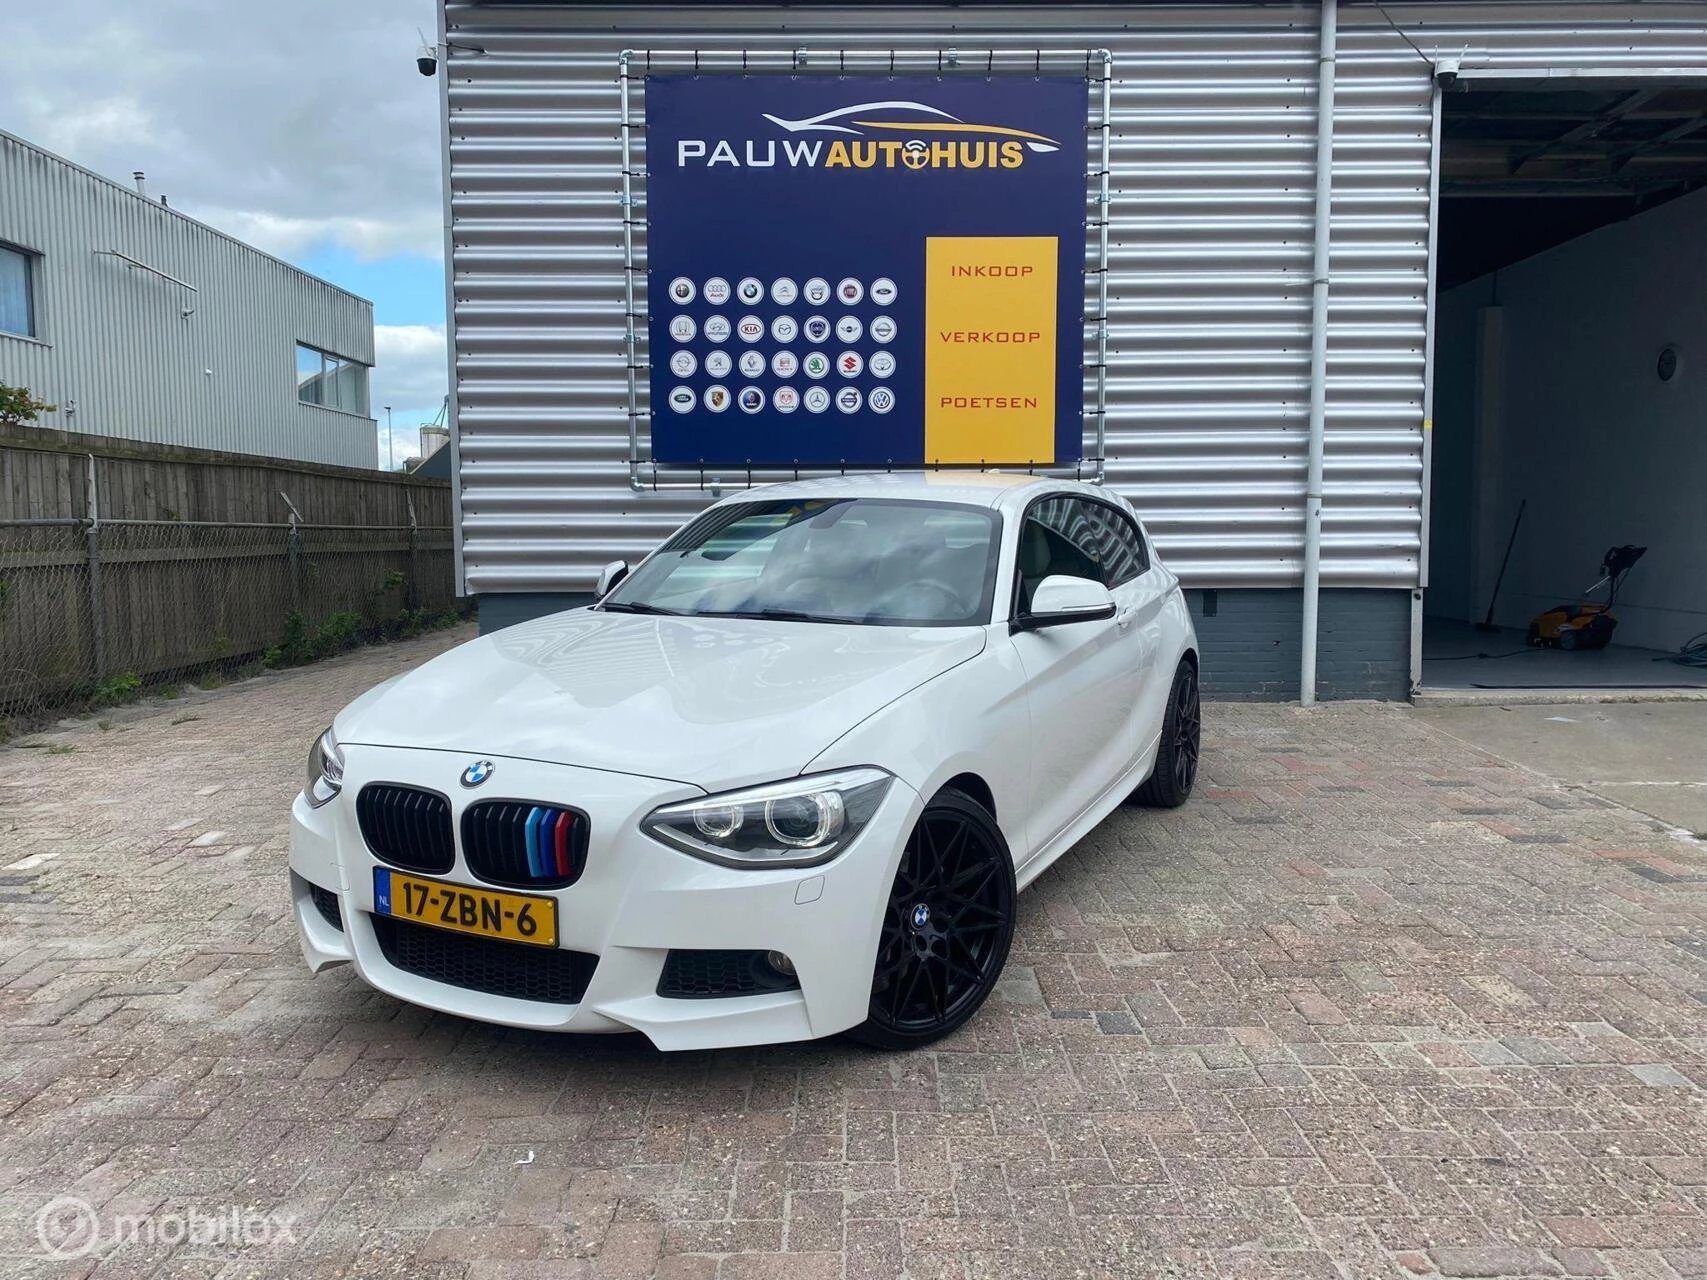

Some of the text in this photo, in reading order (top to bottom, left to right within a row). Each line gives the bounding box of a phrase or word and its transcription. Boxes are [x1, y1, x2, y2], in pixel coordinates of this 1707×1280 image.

[951, 266, 1033, 277] INKOOP
[940, 332, 1040, 343] VERKOOP
[940, 397, 1037, 408] POETSEN
[379, 895, 390, 906] NL
[402, 882, 537, 937] 17-ZBN-6
